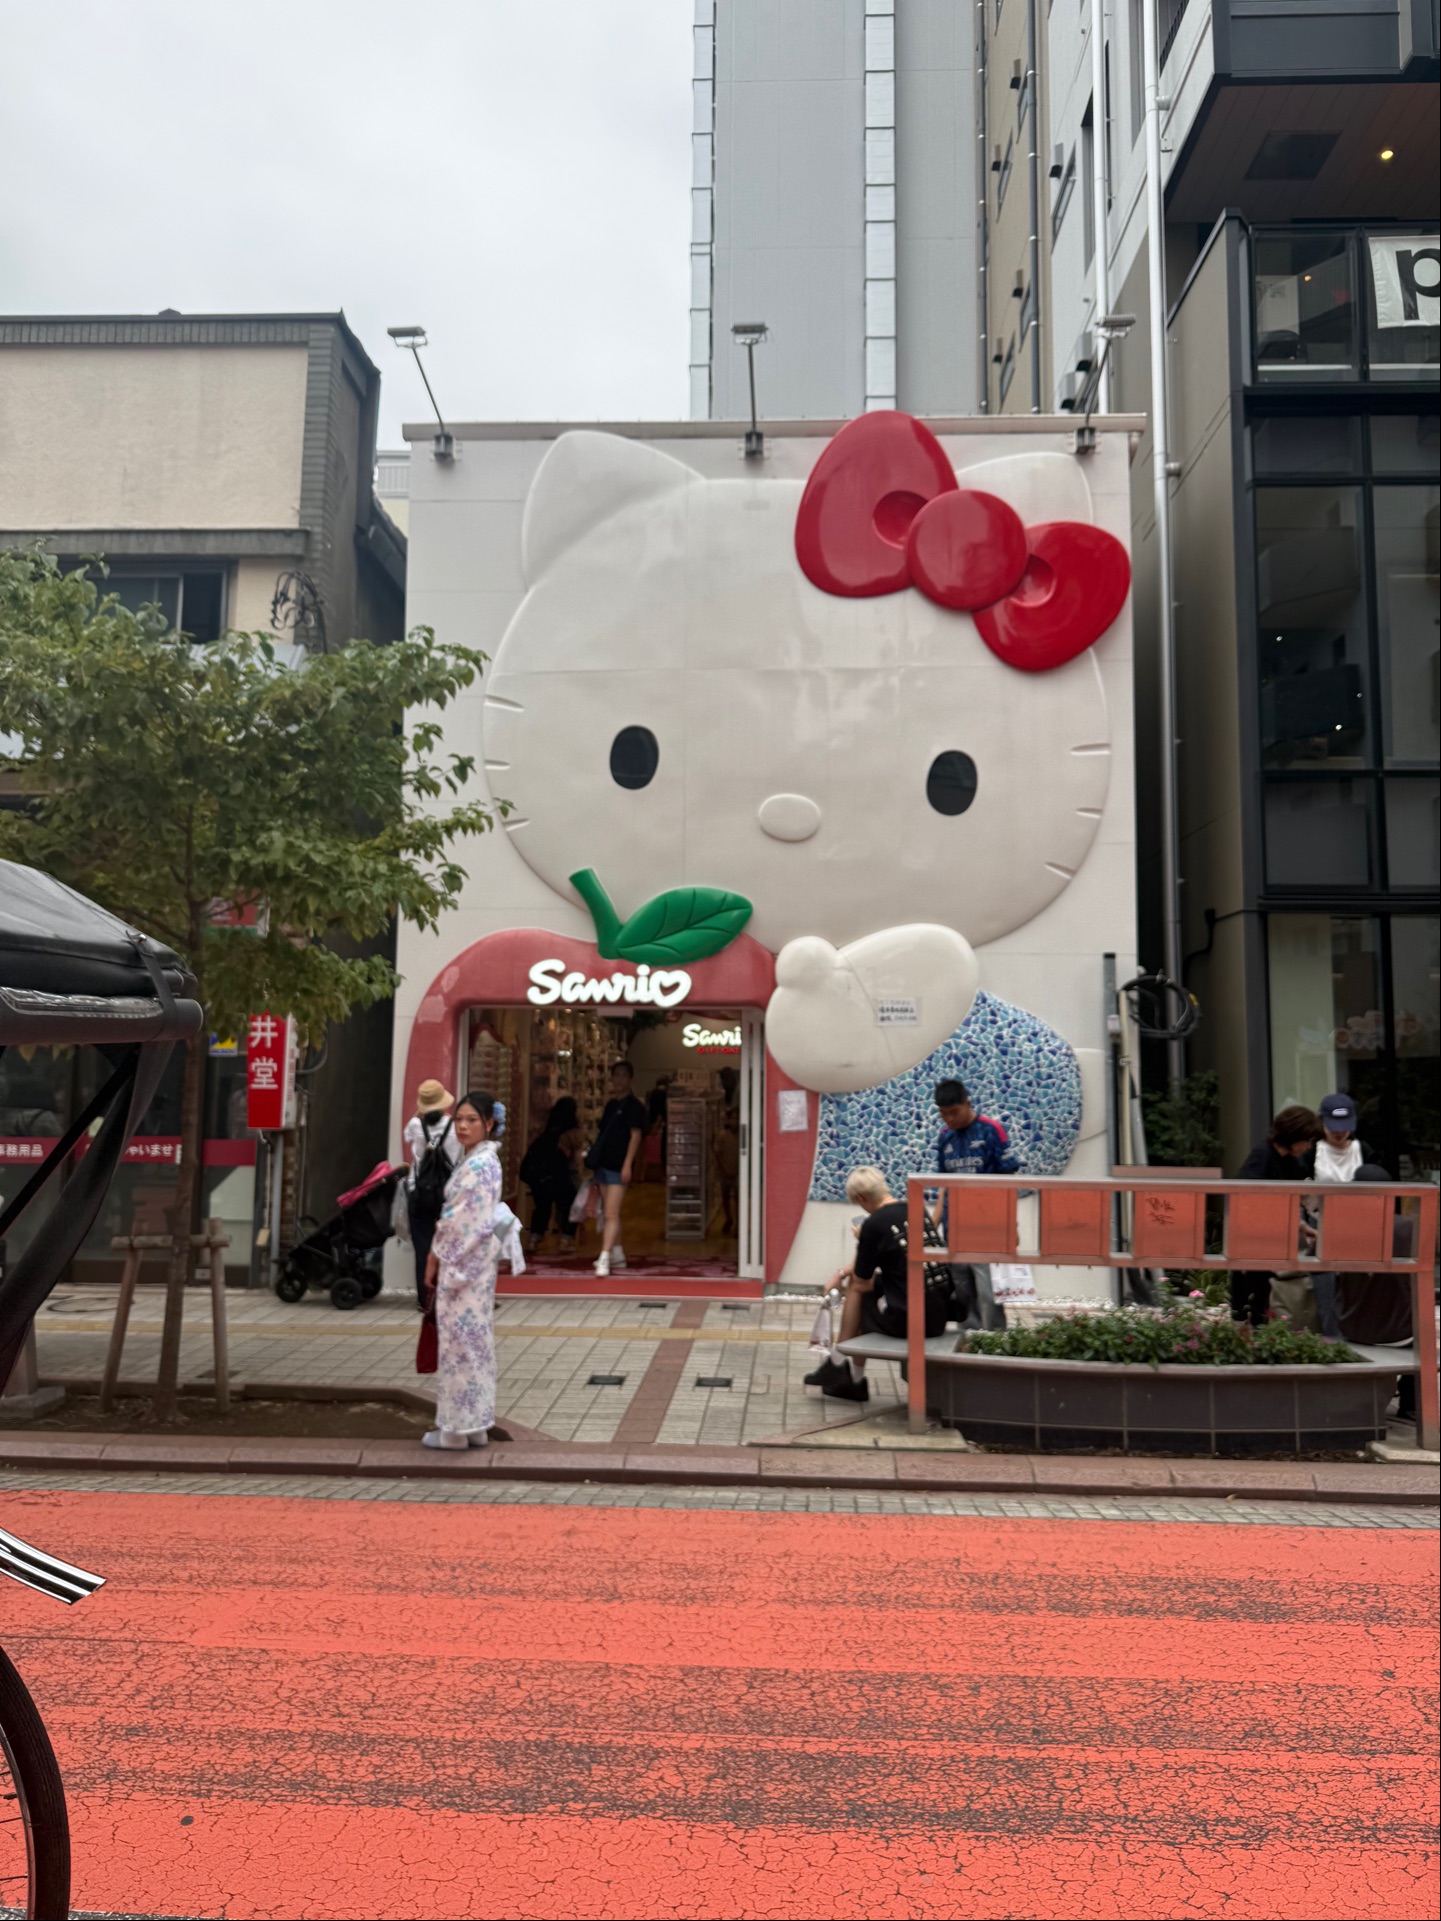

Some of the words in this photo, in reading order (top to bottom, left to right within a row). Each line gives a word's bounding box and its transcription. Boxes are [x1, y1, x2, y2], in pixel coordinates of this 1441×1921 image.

[527, 958, 692, 1008] Sanrio
[126, 1143, 174, 1158] ゃいませ
